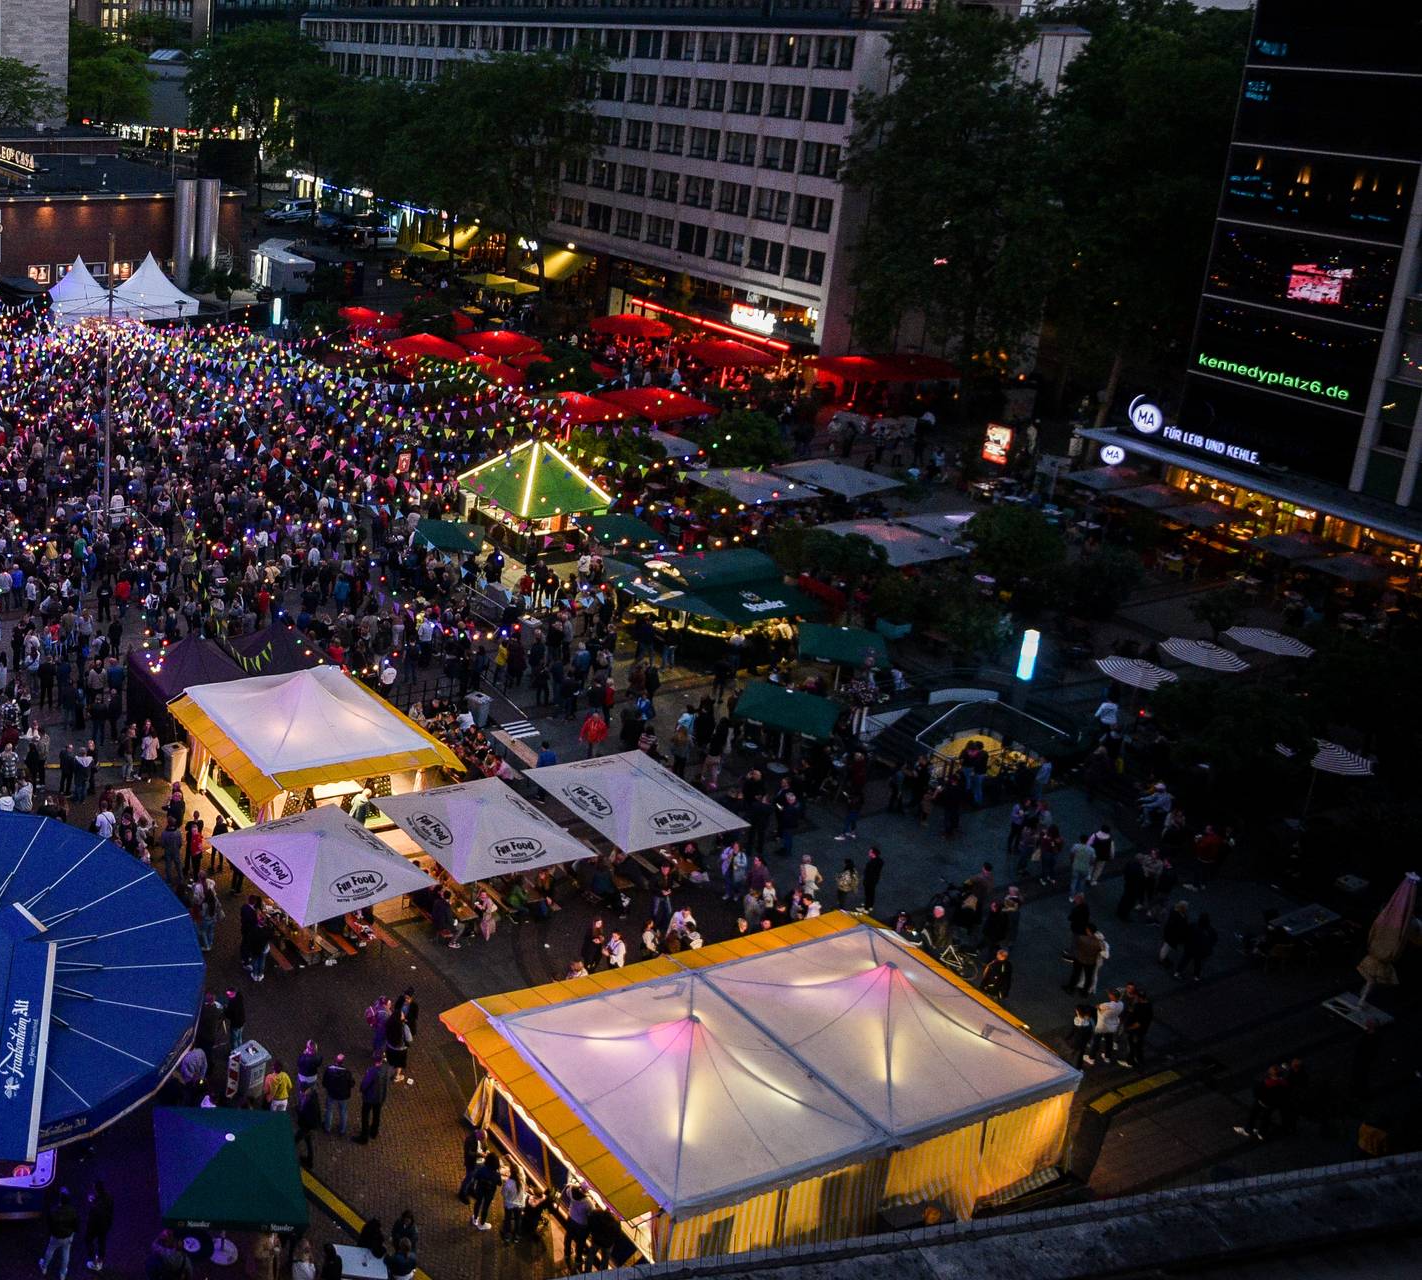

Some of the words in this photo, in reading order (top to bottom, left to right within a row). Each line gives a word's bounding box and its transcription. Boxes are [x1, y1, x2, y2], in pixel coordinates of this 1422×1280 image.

[15, 149, 35, 169] CASA
[1197, 352, 1349, 401] kennedyplatz6.de
[1137, 410, 1155, 426] MA
[1163, 425, 1181, 442] FÜR
[1183, 432, 1203, 448] LEIB
[1205, 438, 1224, 455] UND
[1225, 444, 1260, 465] KEHLE.
[587, 794, 606, 812] Food
[667, 812, 691, 821] Food
[430, 822, 449, 842] Food
[510, 840, 535, 850] Food
[254, 852, 272, 865] Fun
[270, 861, 289, 881] Food
[336, 881, 352, 894] Fun
[351, 873, 376, 885] Food
[0, 1017, 31, 1078] Frankenheim
